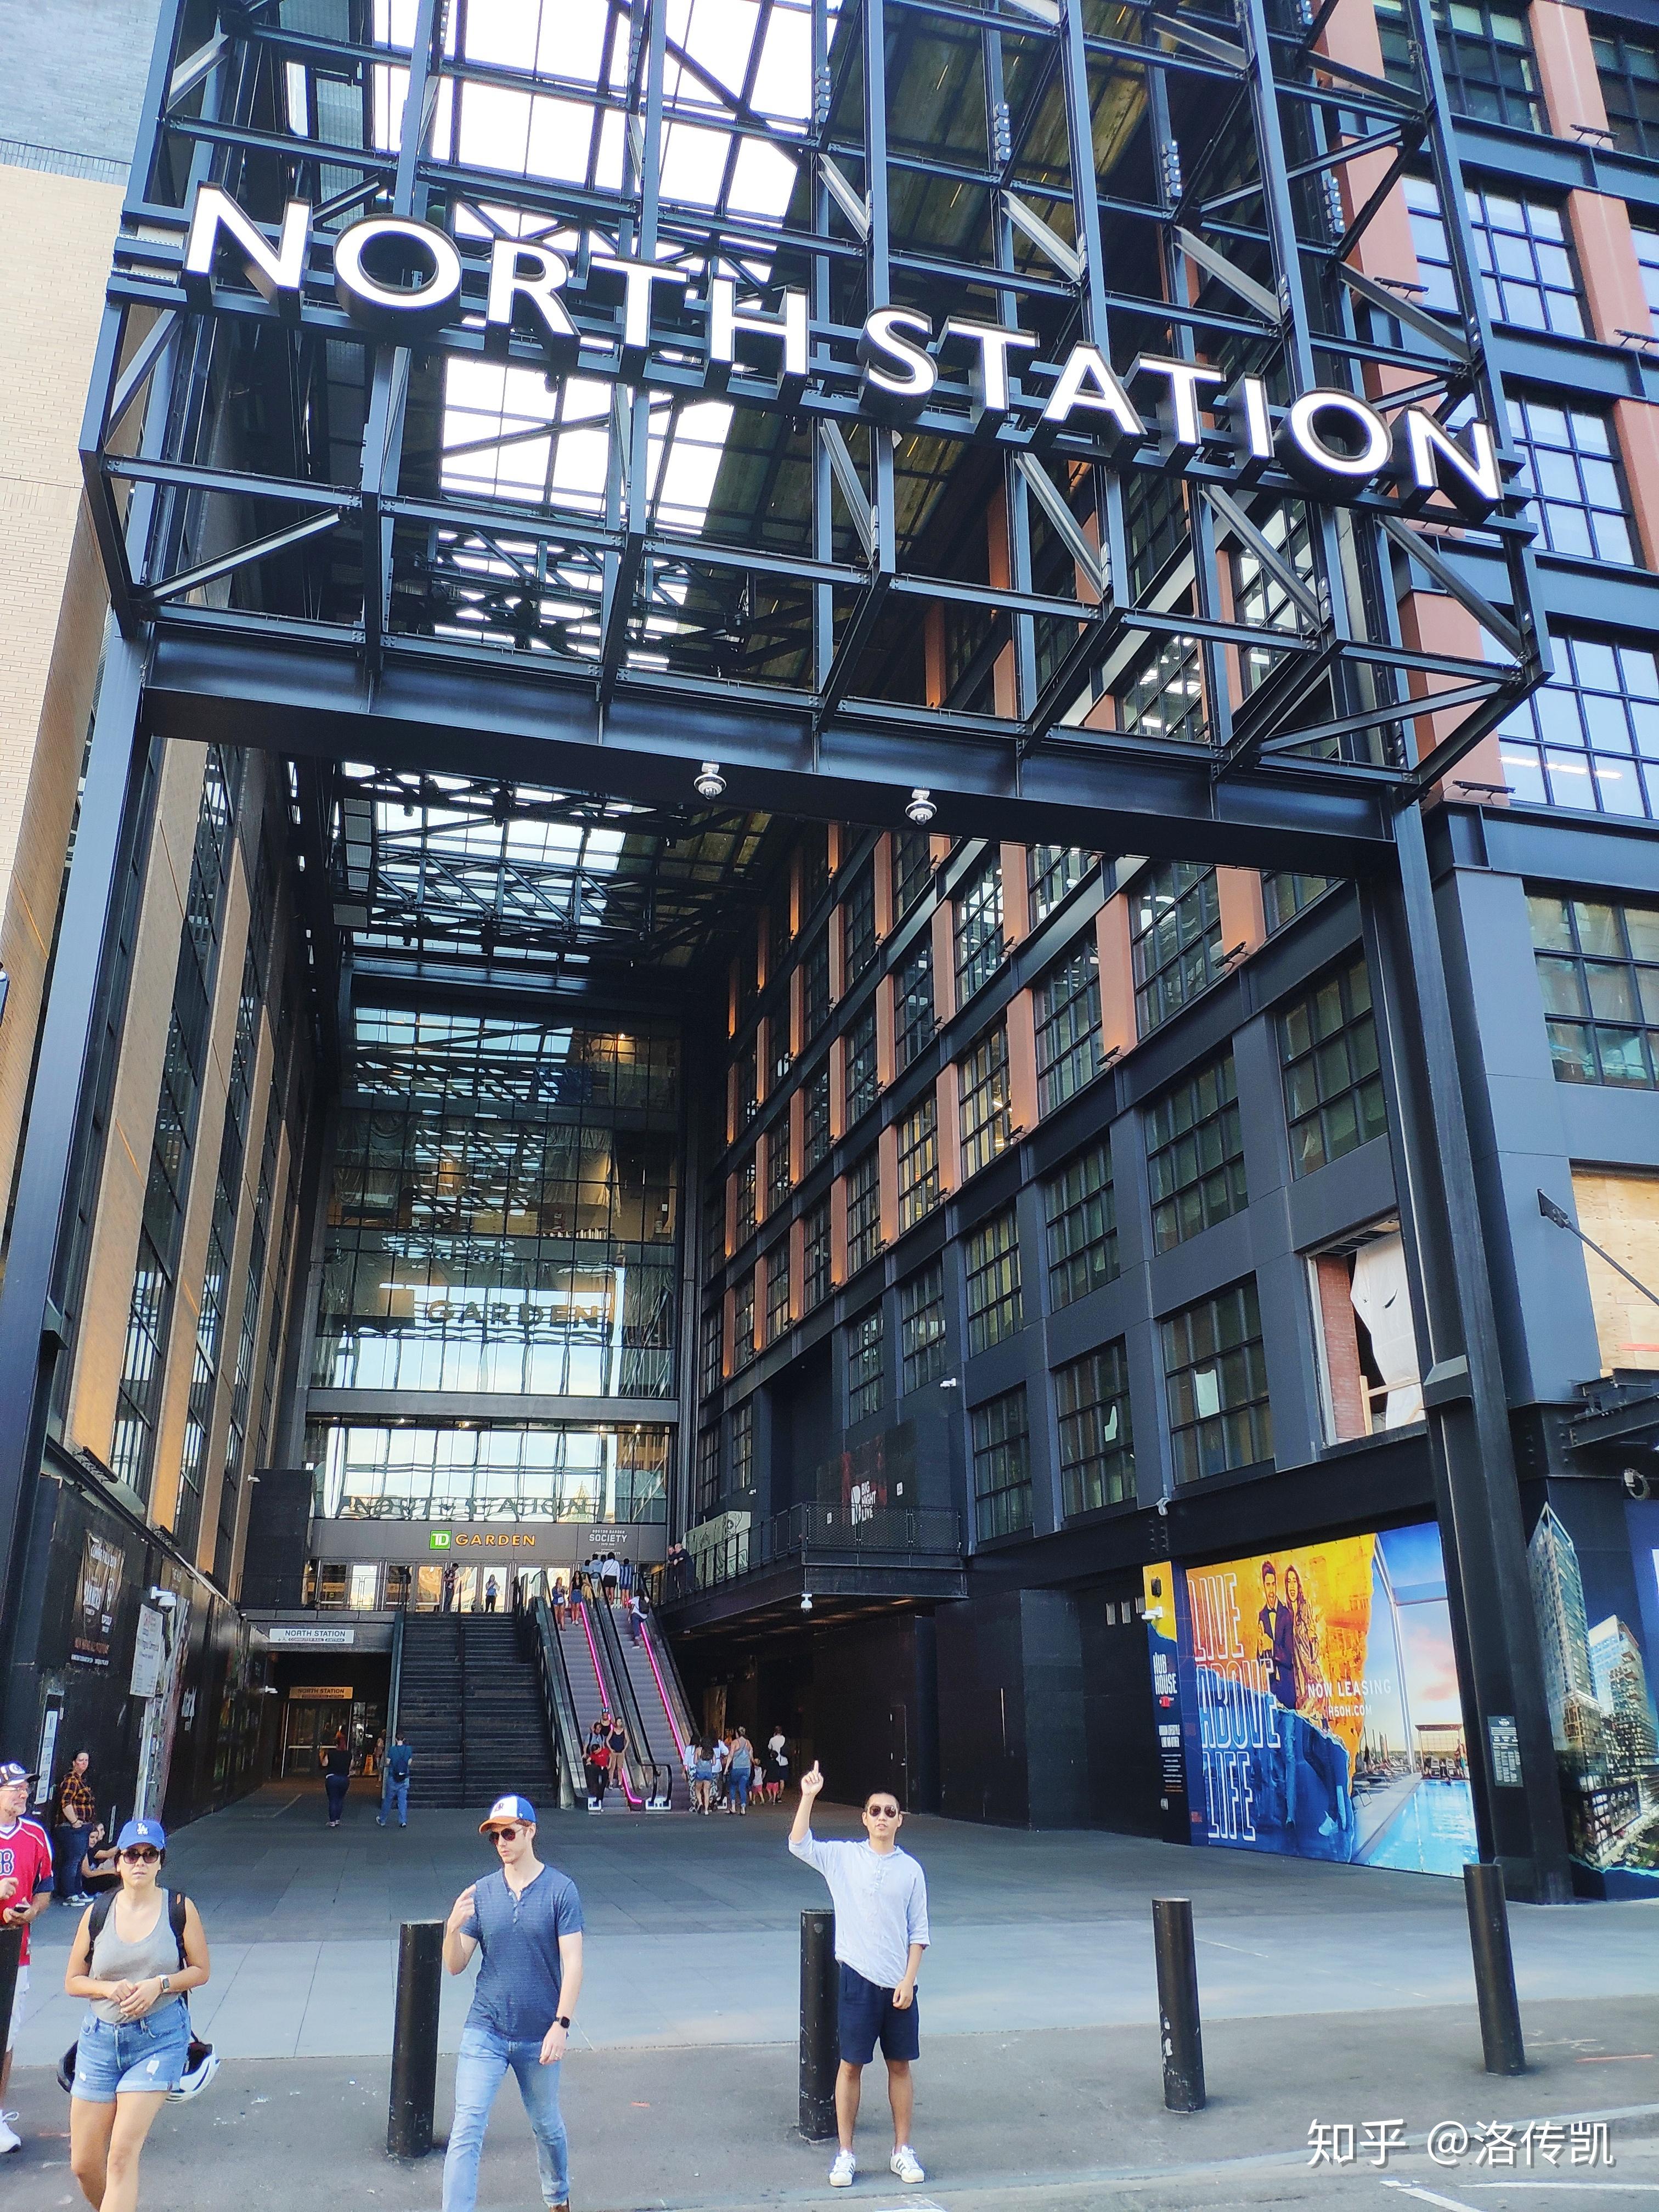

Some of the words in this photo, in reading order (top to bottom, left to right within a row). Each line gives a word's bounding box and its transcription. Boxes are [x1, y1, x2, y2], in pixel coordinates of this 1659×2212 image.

[184, 183, 810, 377] NORTH
[864, 308, 1502, 503] STATION
[428, 1300, 598, 1328] GARDEN
[861, 1481, 870, 1496] BIG
[861, 1490, 876, 1508] NIGHT
[862, 1507, 873, 1521] LIVE
[432, 1533, 449, 1546] TD
[455, 1533, 536, 1547] GARDEN
[589, 1534, 628, 1543] SOCIETY
[1188, 1572, 1244, 1661] LIVE
[1153, 1651, 1167, 1674] HUB
[1154, 1673, 1177, 1695] HOUSE
[1307, 1682, 1333, 1699] NOW
[1338, 1679, 1392, 1697] LEASING
[1196, 1658, 1281, 1748] ABOVE
[1203, 1752, 1256, 1842] LIFE
[137, 1822, 148, 1835] LA
